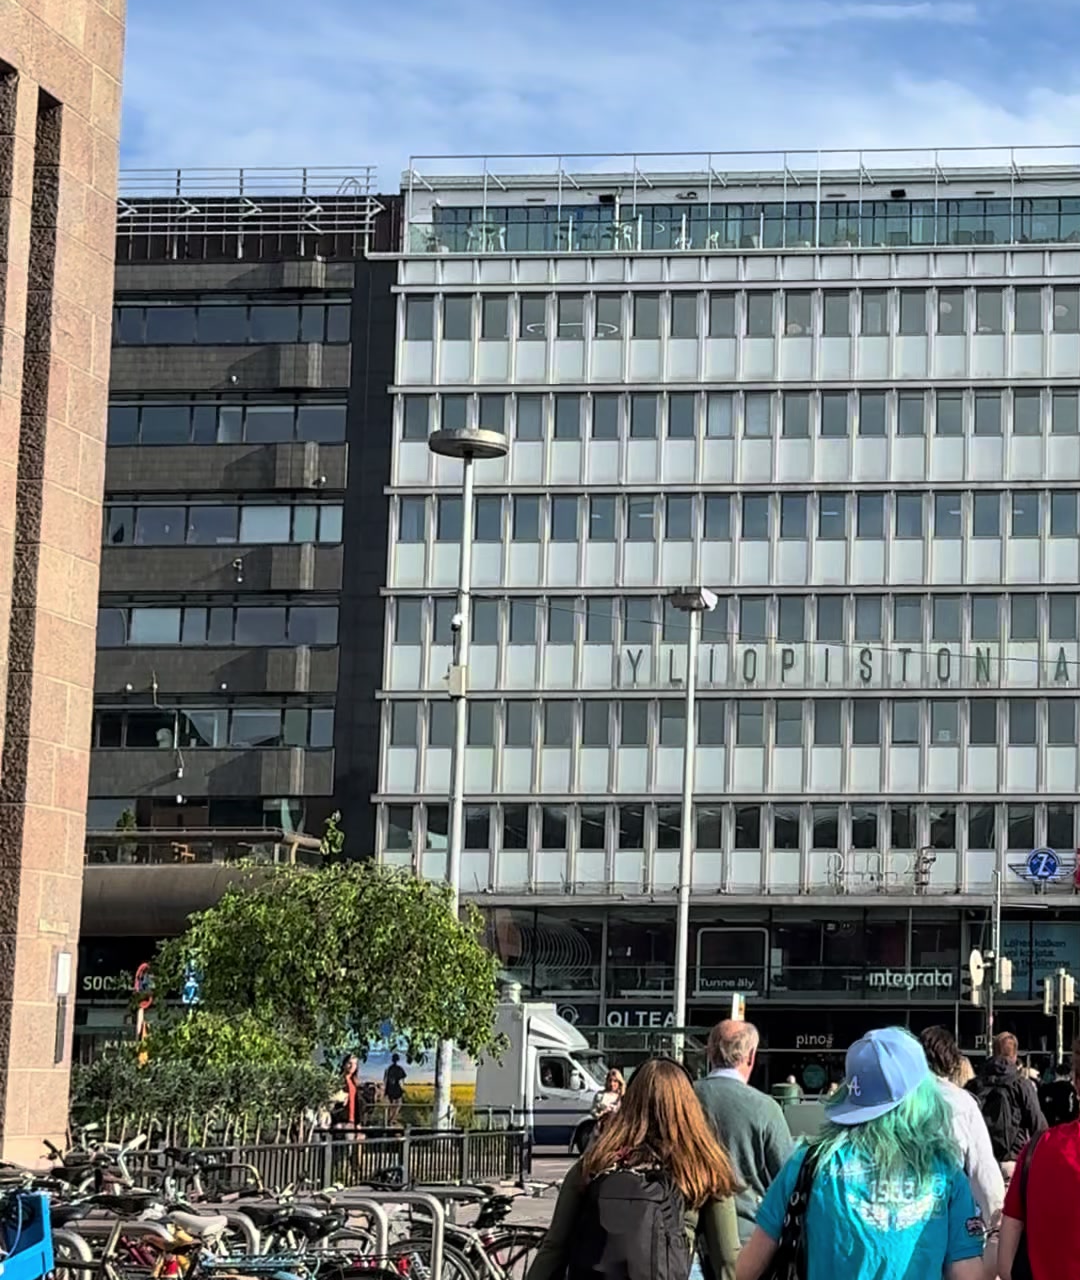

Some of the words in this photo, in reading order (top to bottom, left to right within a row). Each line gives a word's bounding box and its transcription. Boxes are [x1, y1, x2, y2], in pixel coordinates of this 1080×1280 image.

[626, 647, 991, 683] YLIOPISTON
[869, 969, 953, 991] integrata
[607, 1011, 626, 1028] QI
[635, 1011, 677, 1028] TEA
[796, 1033, 827, 1049] pino
